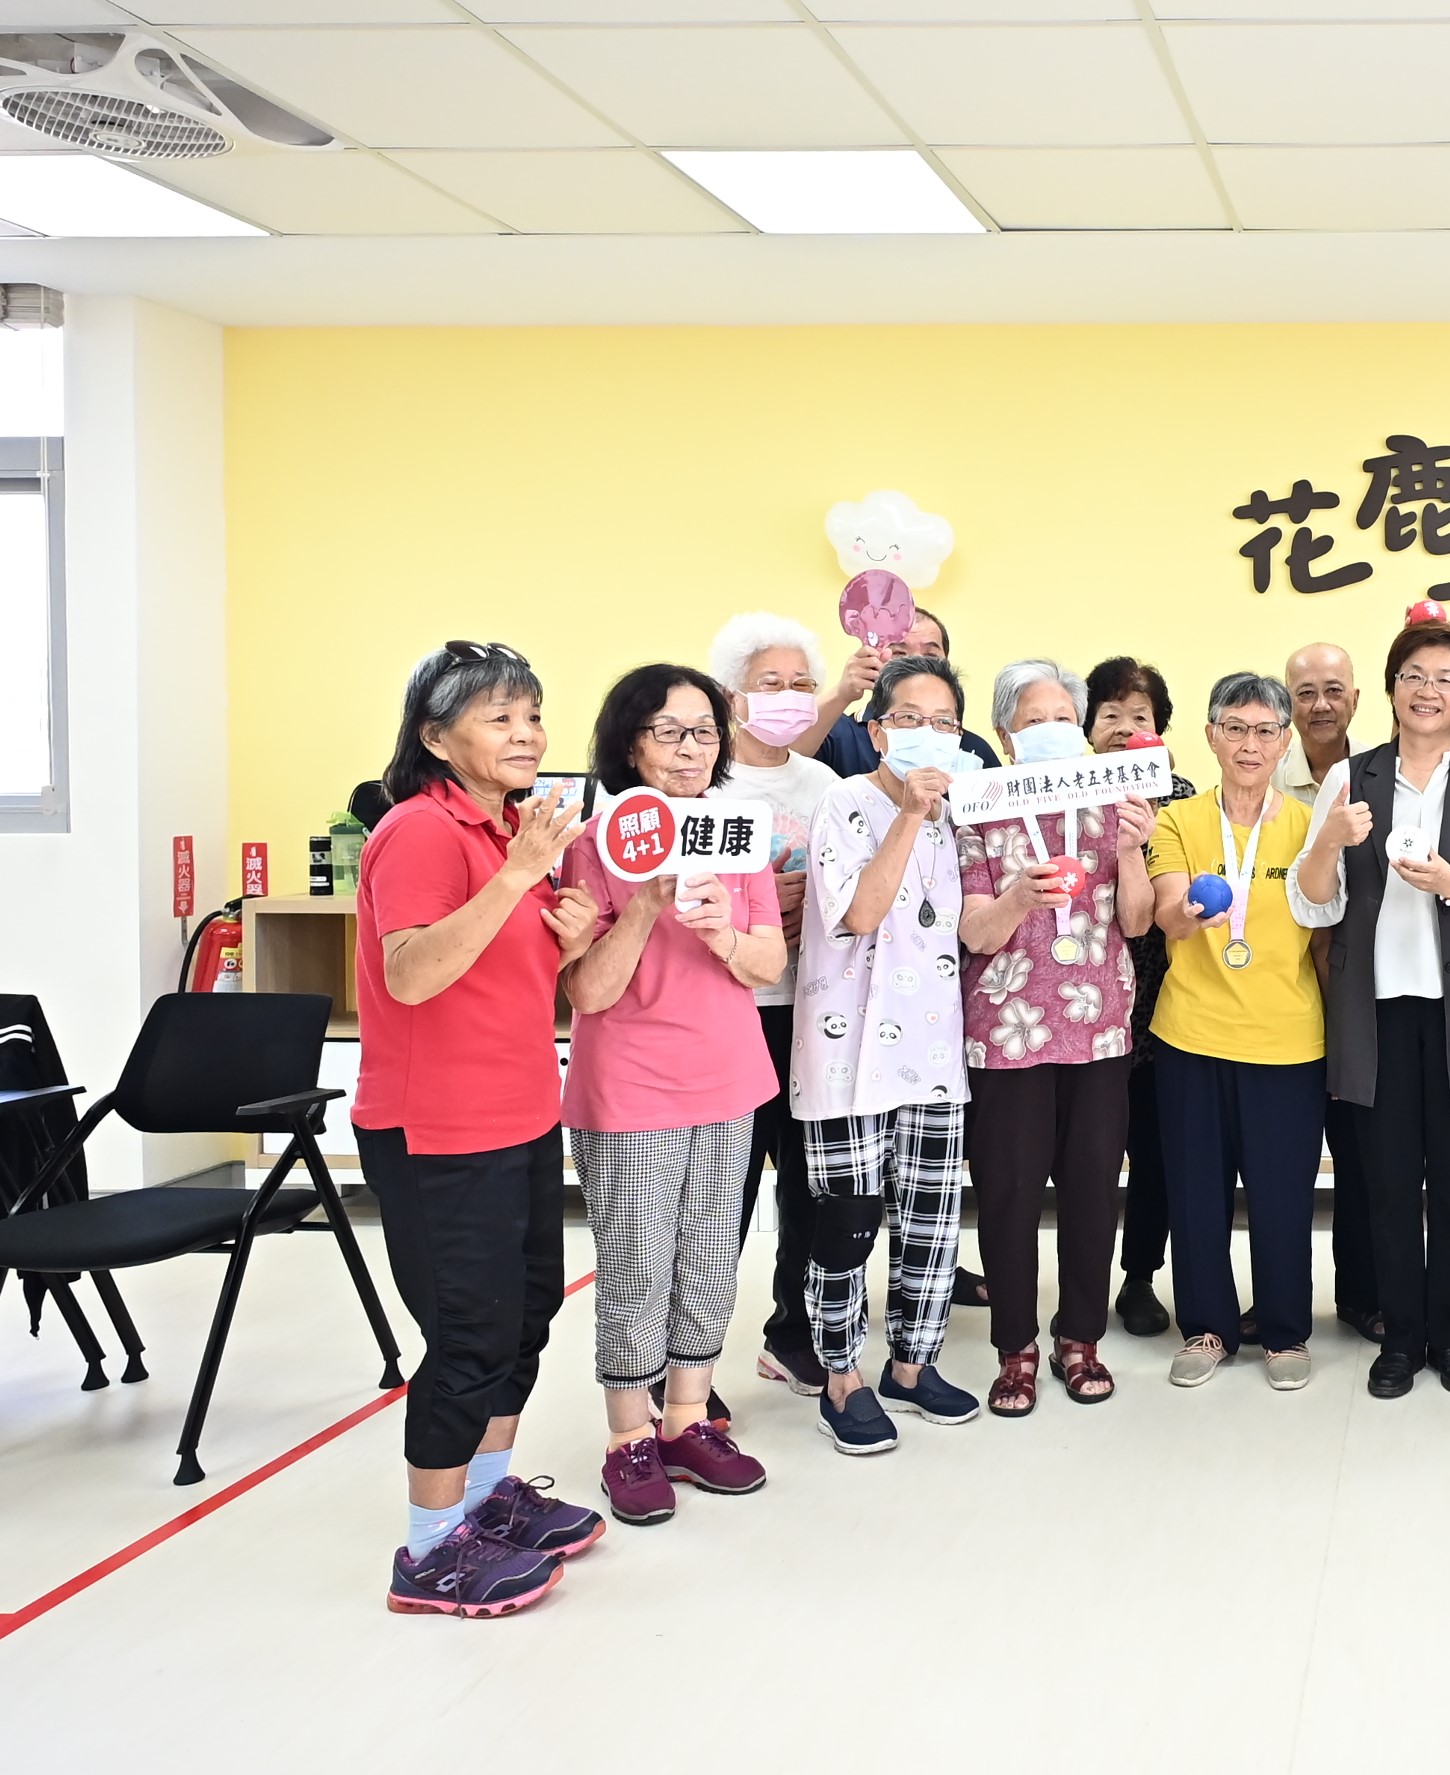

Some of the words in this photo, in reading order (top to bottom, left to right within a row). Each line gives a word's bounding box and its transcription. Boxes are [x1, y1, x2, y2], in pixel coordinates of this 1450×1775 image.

[1006, 761, 1160, 797] 財團法人老五老基金會
[1008, 799, 1030, 807] OLD
[1036, 794, 1061, 805] FIVE
[1067, 790, 1089, 800] OLD
[1095, 781, 1160, 796] FOUNDATION
[618, 807, 661, 840] 照顧
[962, 800, 990, 814] OFO
[622, 833, 665, 862] 4+1
[681, 815, 754, 856] 健康
[177, 851, 190, 892] 滅火器
